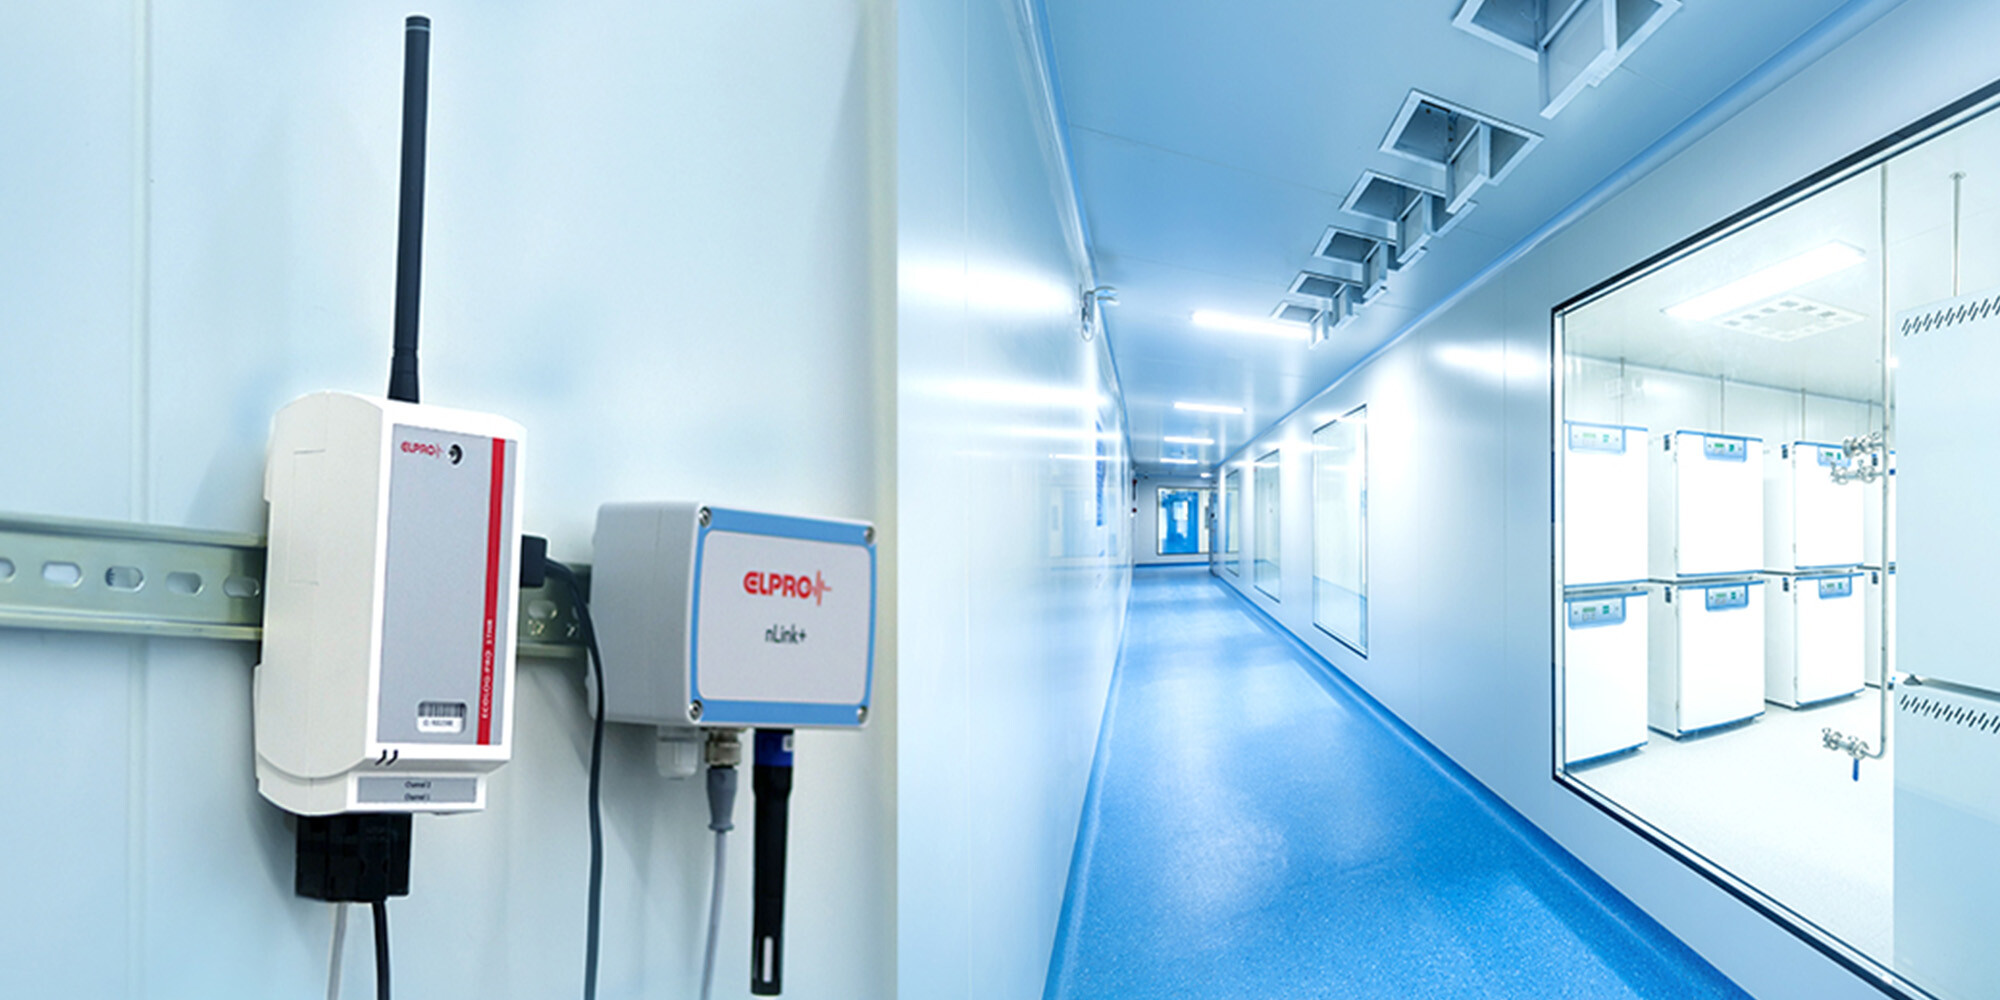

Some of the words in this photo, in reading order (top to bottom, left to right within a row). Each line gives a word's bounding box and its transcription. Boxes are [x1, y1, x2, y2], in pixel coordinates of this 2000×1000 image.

[400, 441, 436, 456] ELPRO
[743, 571, 812, 599] ELPRO
[765, 624, 806, 644] nLink+
